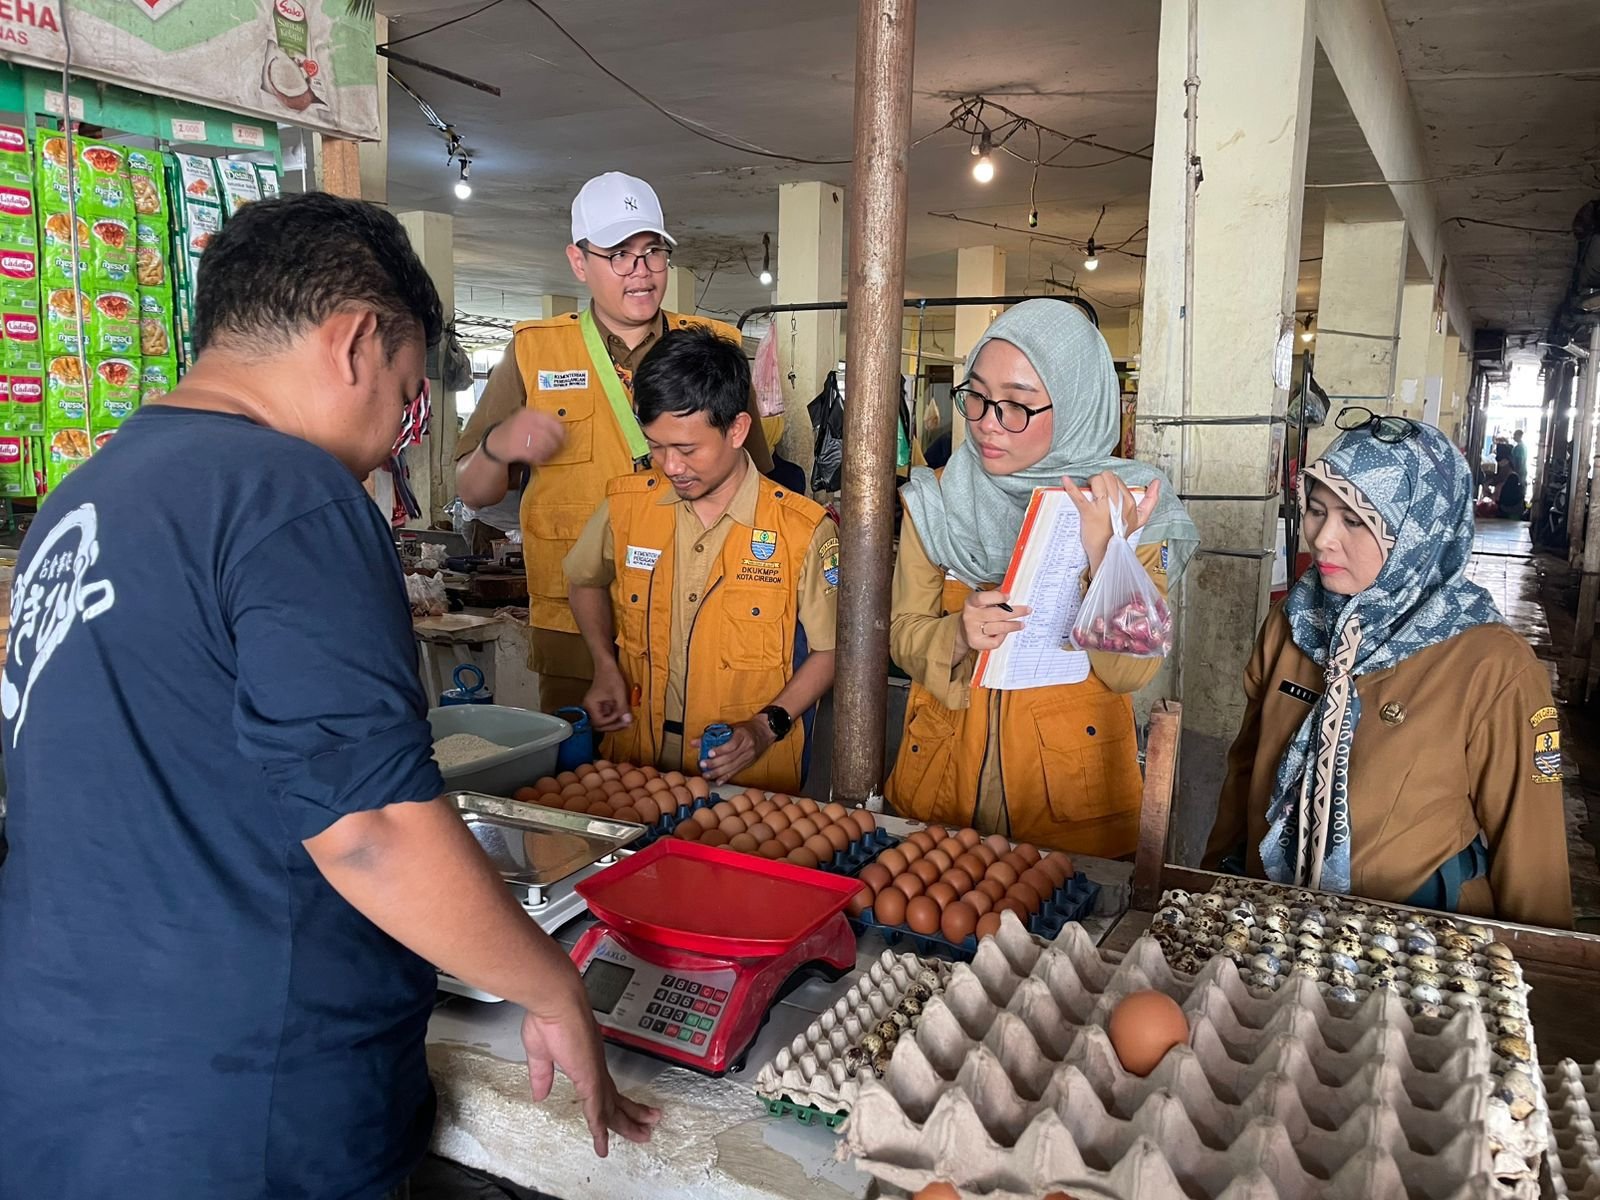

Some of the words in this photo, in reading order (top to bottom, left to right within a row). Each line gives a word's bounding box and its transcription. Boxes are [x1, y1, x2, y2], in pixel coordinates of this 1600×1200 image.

[102, 258, 130, 273] Desaku
[104, 333, 132, 345] Desaku
[104, 399, 133, 412] Desaku
[741, 566, 779, 576] DKUKMPP
[736, 573, 753, 581] KOTA
[754, 574, 782, 584] CIREBON
[664, 976, 673, 985] 7
[676, 980, 686, 989] 8
[689, 983, 698, 993] 9
[669, 994, 678, 1003] 5
[682, 997, 691, 1006] 6
[662, 1008, 671, 1017] 2
[675, 1011, 684, 1020] 3
